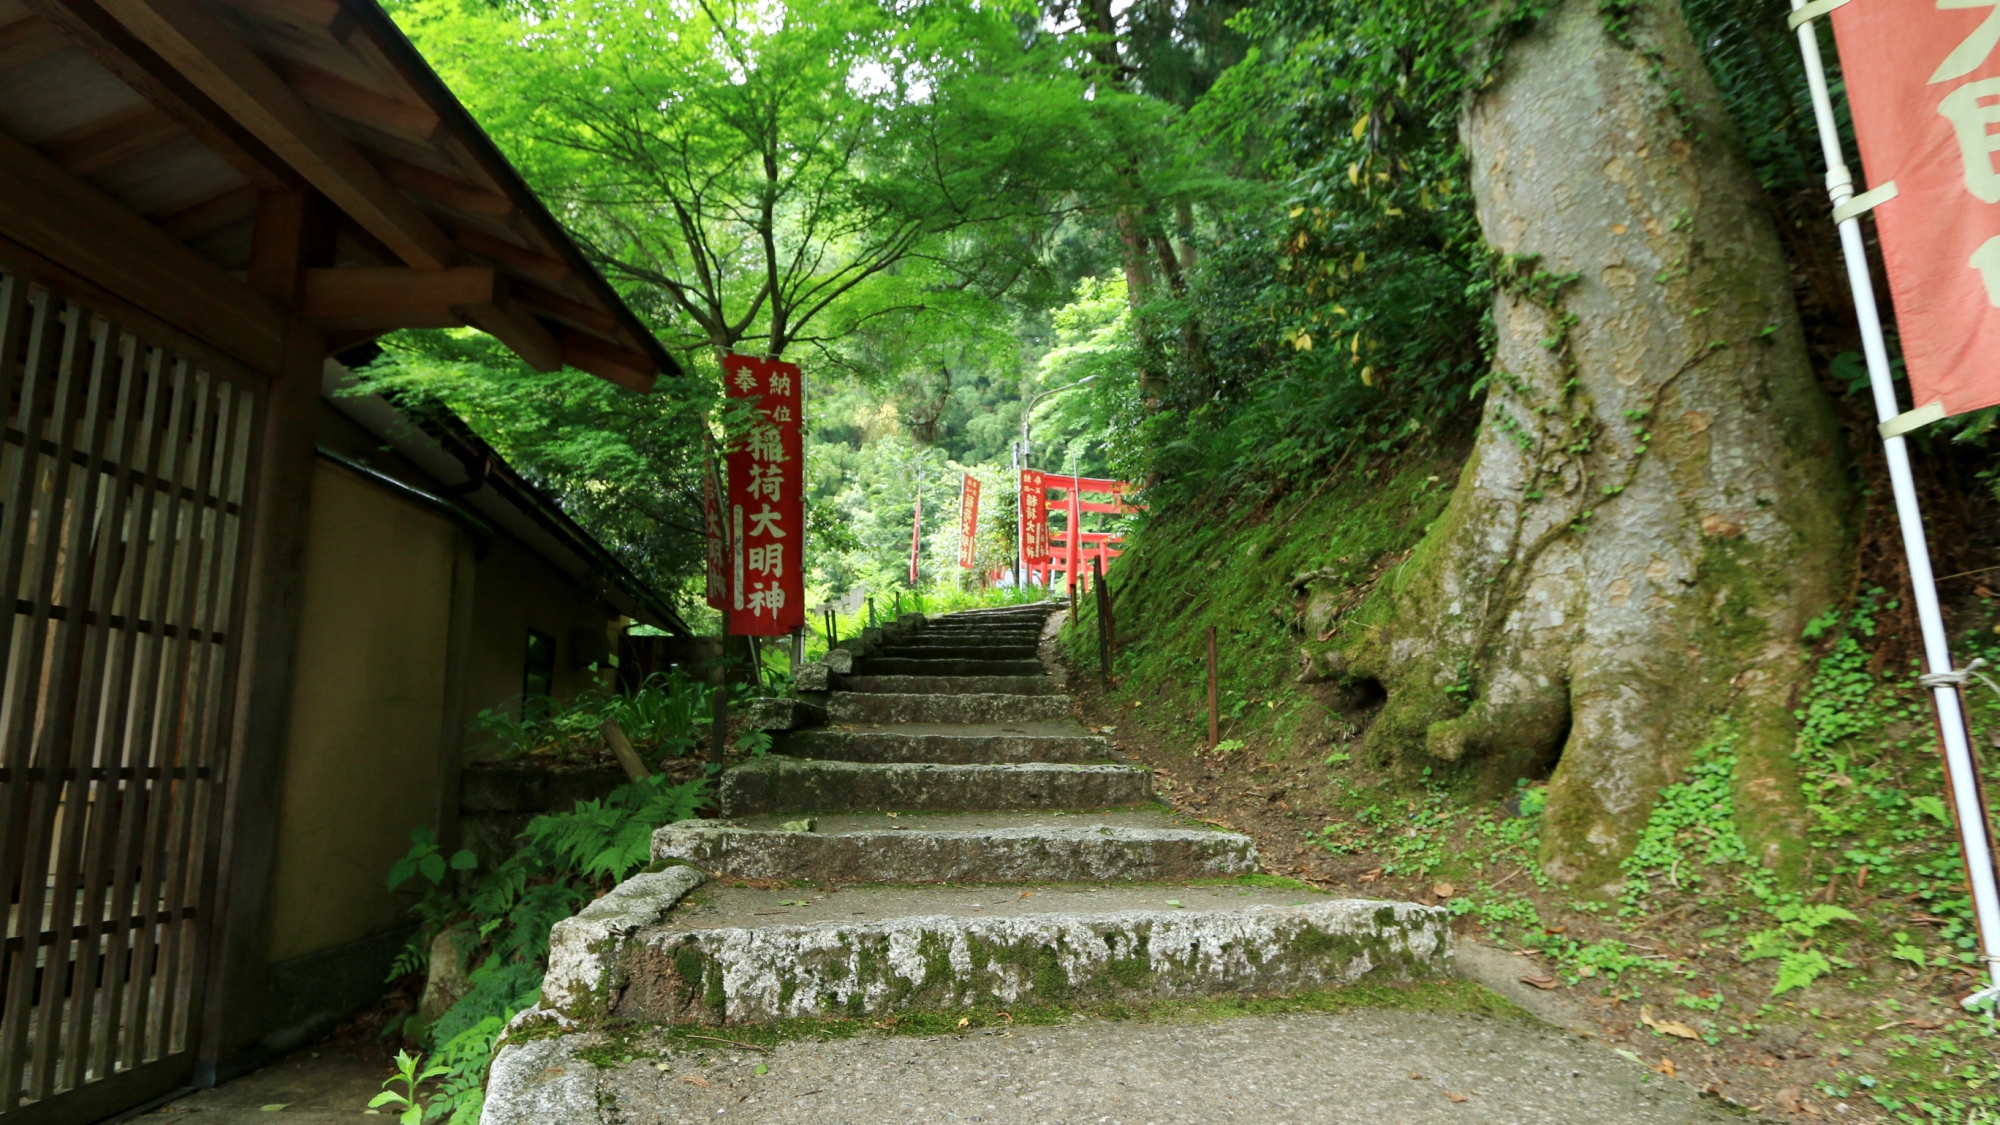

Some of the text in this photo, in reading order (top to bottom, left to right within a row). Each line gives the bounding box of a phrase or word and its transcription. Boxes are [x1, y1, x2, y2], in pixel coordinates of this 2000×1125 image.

[734, 366, 791, 396] 奉納
[738, 402, 792, 423] 一位
[745, 427, 787, 620] 稲荷大明神
